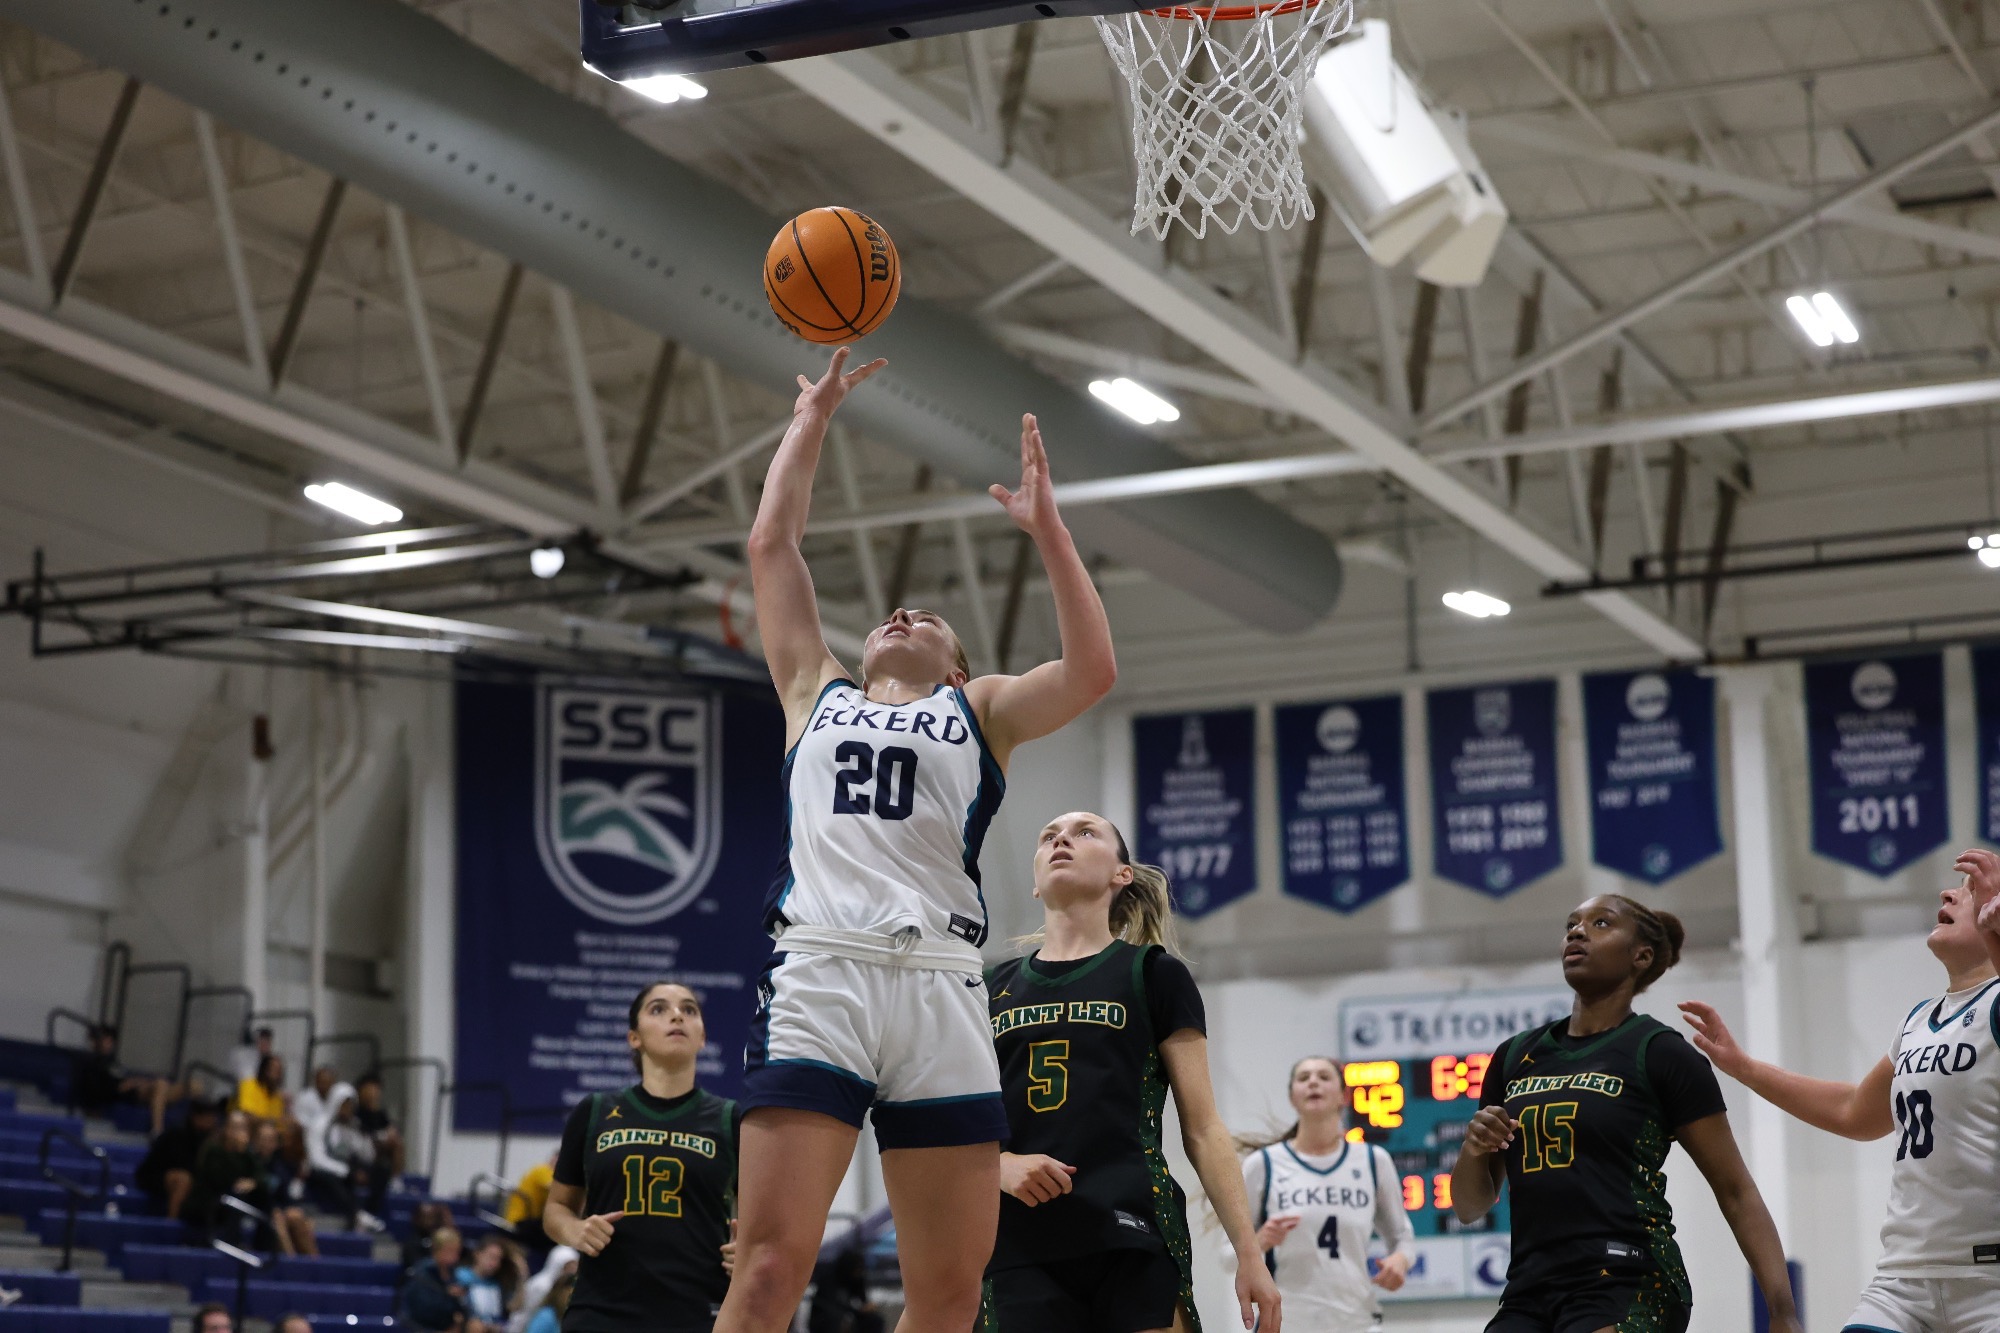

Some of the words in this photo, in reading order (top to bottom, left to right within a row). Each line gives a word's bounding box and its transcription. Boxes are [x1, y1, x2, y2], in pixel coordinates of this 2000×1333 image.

[562, 701, 697, 753] SSC
[812, 705, 969, 745] ECKERD
[832, 740, 918, 820] 20
[1839, 794, 1919, 833] 2011
[1159, 845, 1232, 878] 1977
[969, 928, 976, 936] M
[1068, 1001, 1127, 1030] LEO
[1388, 1009, 1533, 1044] TRITONS
[1028, 1040, 1069, 1113] 5
[1504, 1074, 1573, 1102] SAINT
[1569, 1072, 1623, 1097] LEO
[597, 1128, 667, 1153] SAINT
[670, 1131, 716, 1159] LEO
[1518, 1101, 1579, 1173] 15
[1895, 1089, 1934, 1162] 10
[622, 1154, 684, 1217] 12
[1277, 1186, 1370, 1210] ECKERD
[1317, 1211, 1340, 1260] 4
[1631, 1249, 1639, 1257] M
